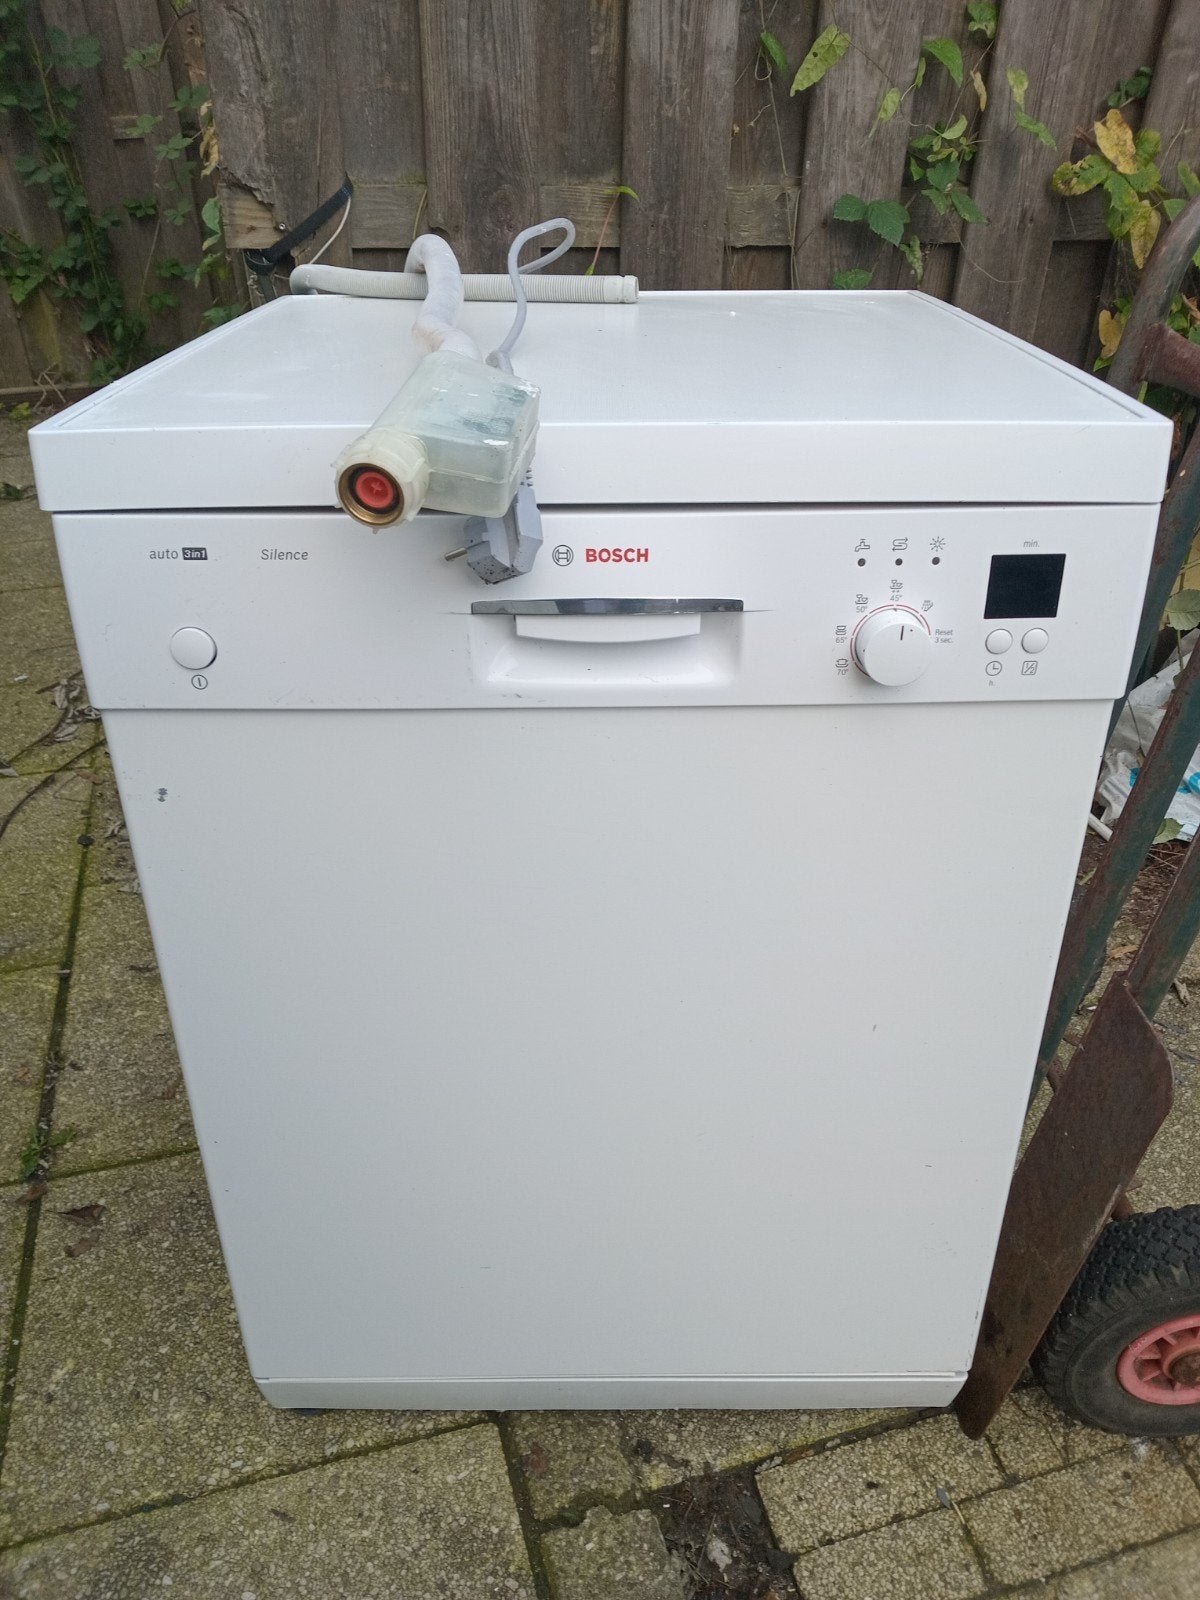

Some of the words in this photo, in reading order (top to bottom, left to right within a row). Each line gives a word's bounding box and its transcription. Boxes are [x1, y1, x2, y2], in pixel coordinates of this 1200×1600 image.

[1023, 539, 1040, 548] min.
[149, 548, 179, 560] auto
[183, 549, 207, 560] 3in1
[261, 548, 309, 561] Silence
[585, 548, 649, 563] BOSCH
[935, 628, 954, 636] Reset
